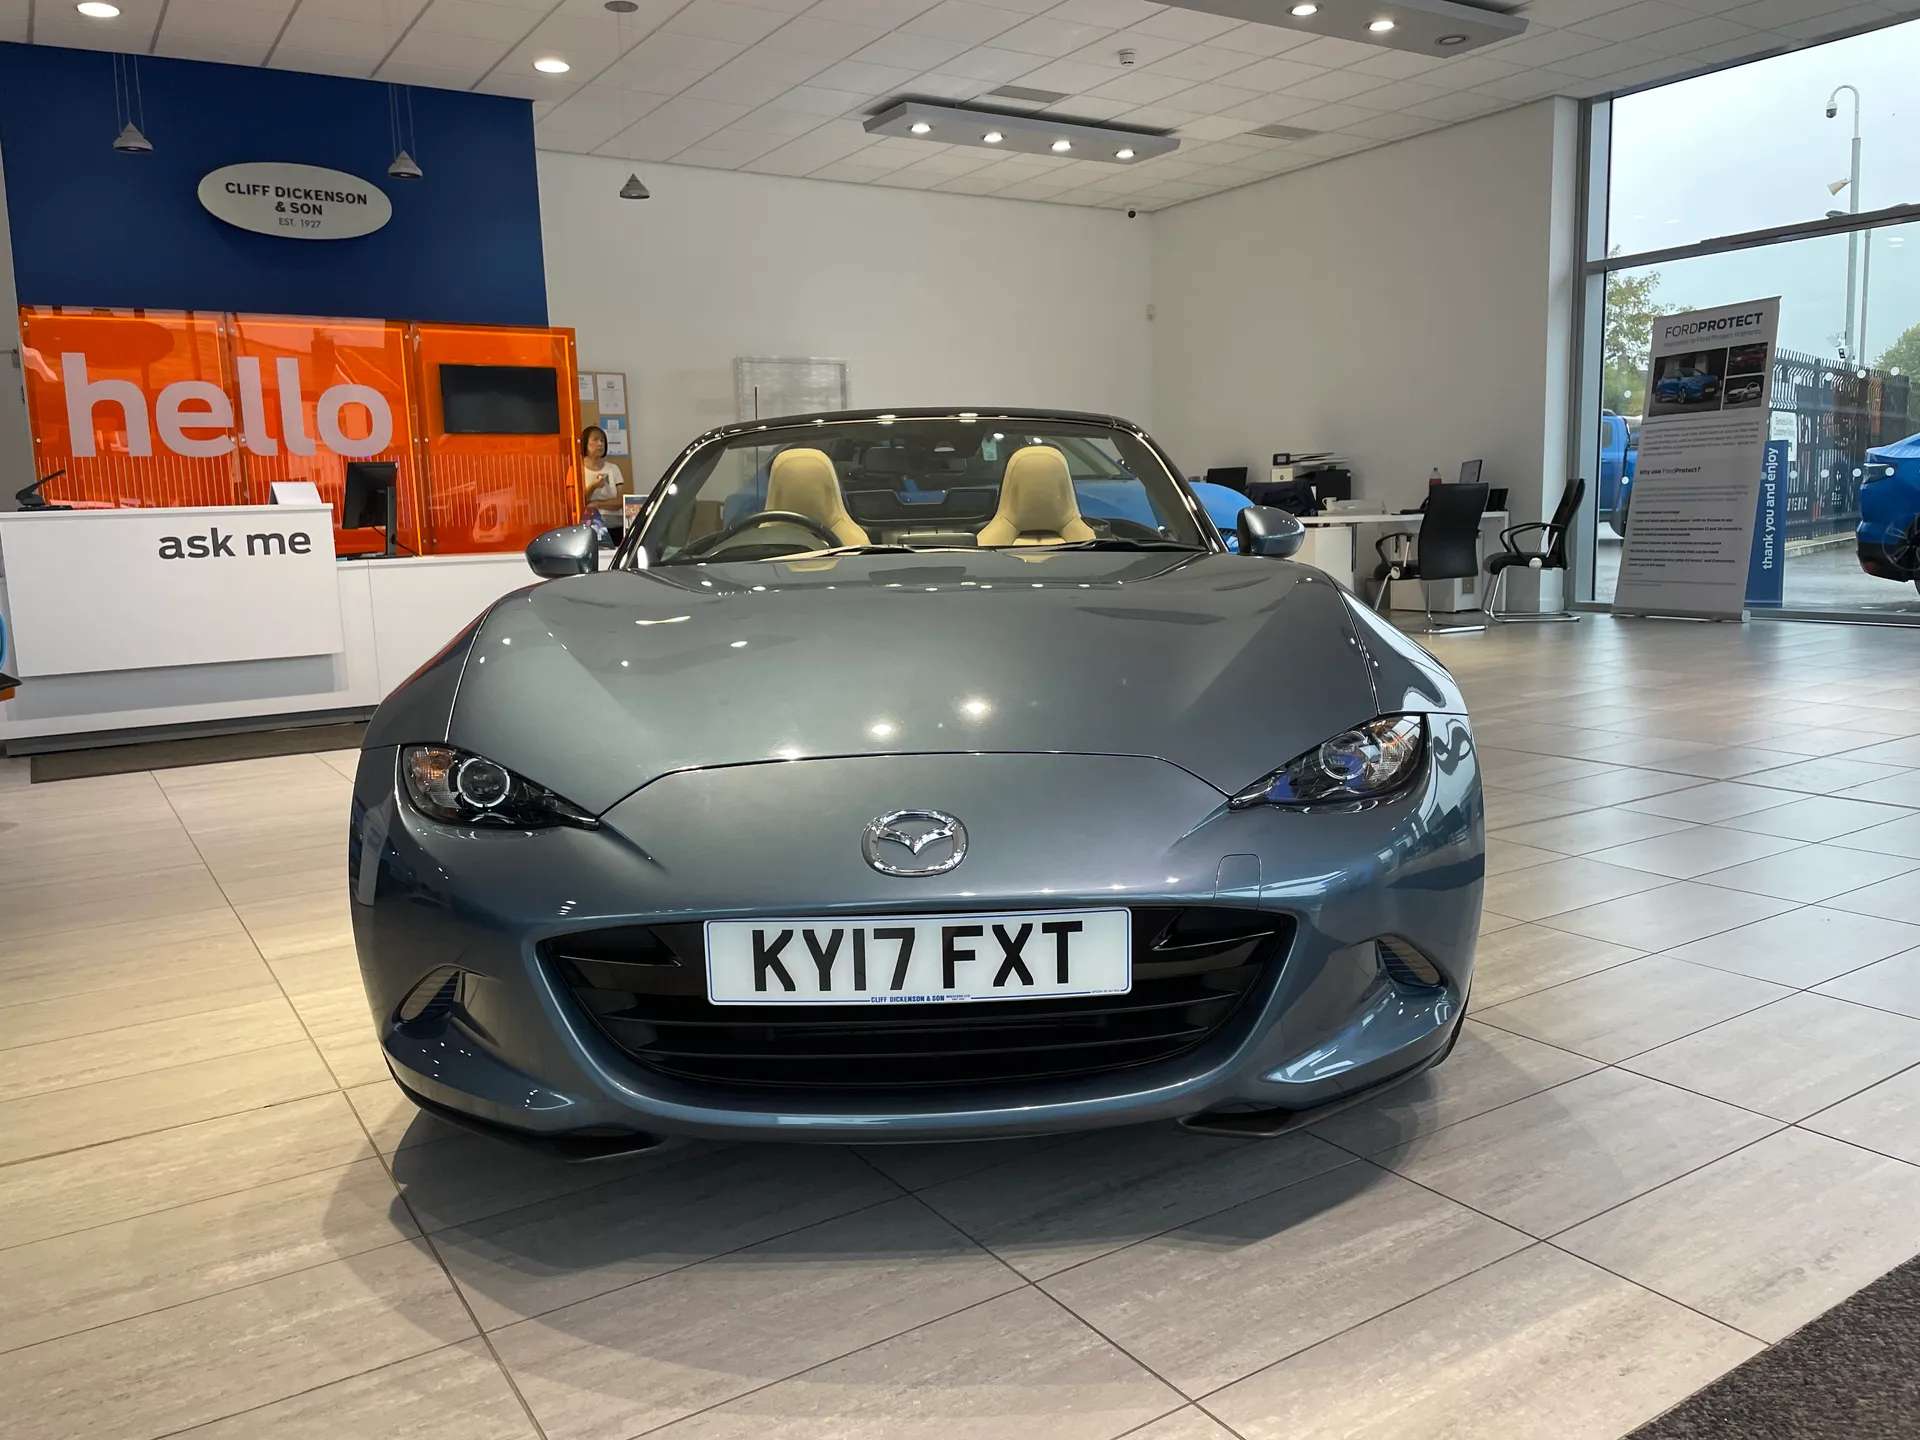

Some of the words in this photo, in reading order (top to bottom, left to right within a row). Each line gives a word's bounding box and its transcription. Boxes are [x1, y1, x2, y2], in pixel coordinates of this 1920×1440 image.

[226, 182, 271, 197] CLIFF
[275, 186, 368, 205] DICKENSON
[275, 201, 286, 213] &
[290, 203, 323, 216] SON
[301, 219, 321, 229] 1927
[61, 352, 394, 457] hello
[1765, 447, 1779, 481] enjoy
[1764, 484, 1776, 506] and
[1765, 509, 1776, 532] you
[159, 528, 236, 559] ask
[246, 532, 312, 556] me
[1762, 535, 1774, 569] thank
[752, 927, 916, 992] KY17
[942, 920, 1083, 990] FXT
